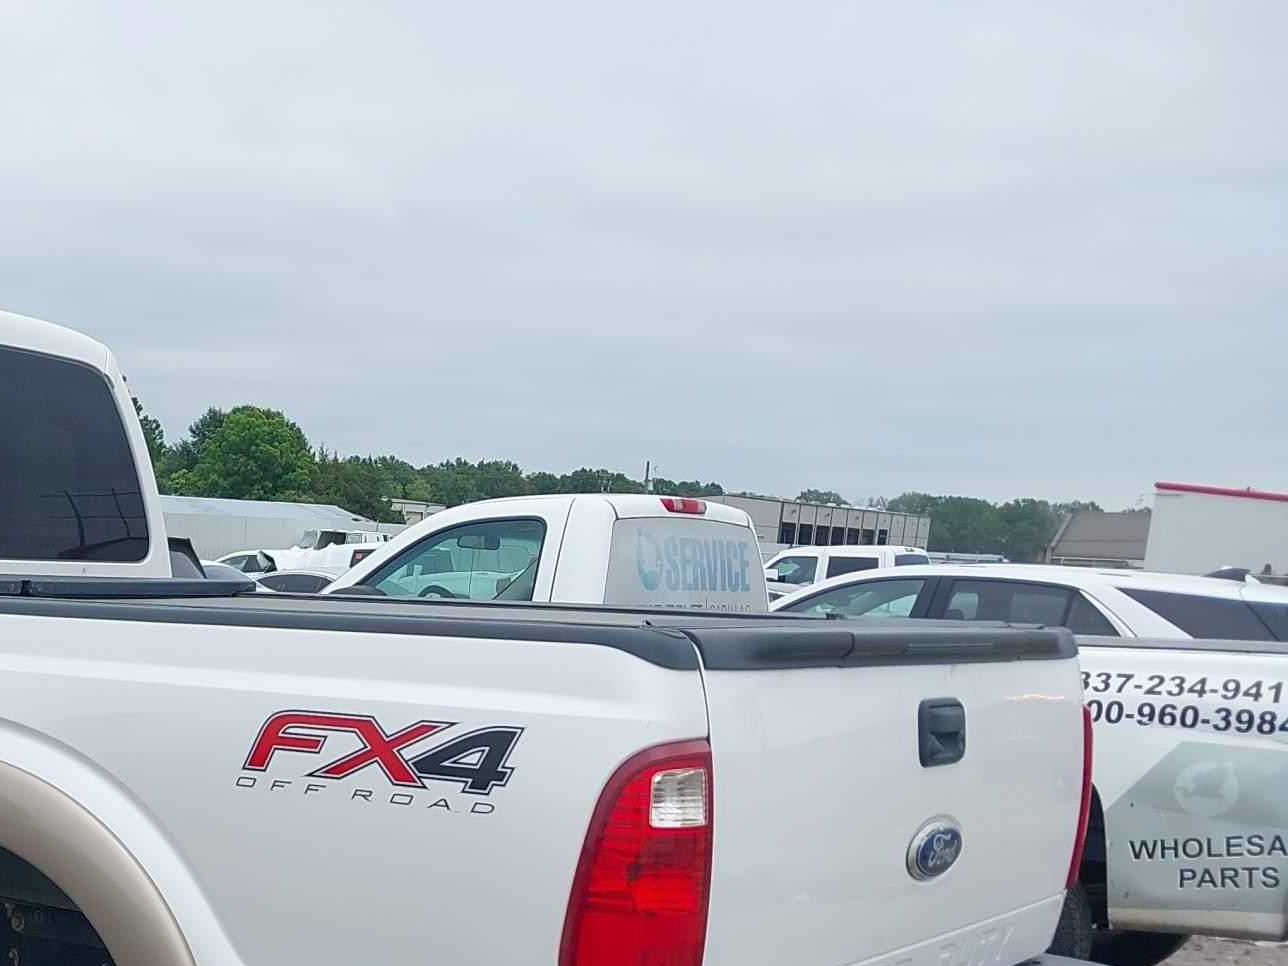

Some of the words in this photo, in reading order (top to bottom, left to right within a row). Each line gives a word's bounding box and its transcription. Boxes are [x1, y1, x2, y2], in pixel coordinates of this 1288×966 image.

[663, 536, 751, 592] SERVICE
[241, 708, 526, 796] FX4
[927, 832, 959, 868] Ford
[1128, 834, 1288, 860] WHOLESA
[1179, 867, 1280, 888] PARTS
